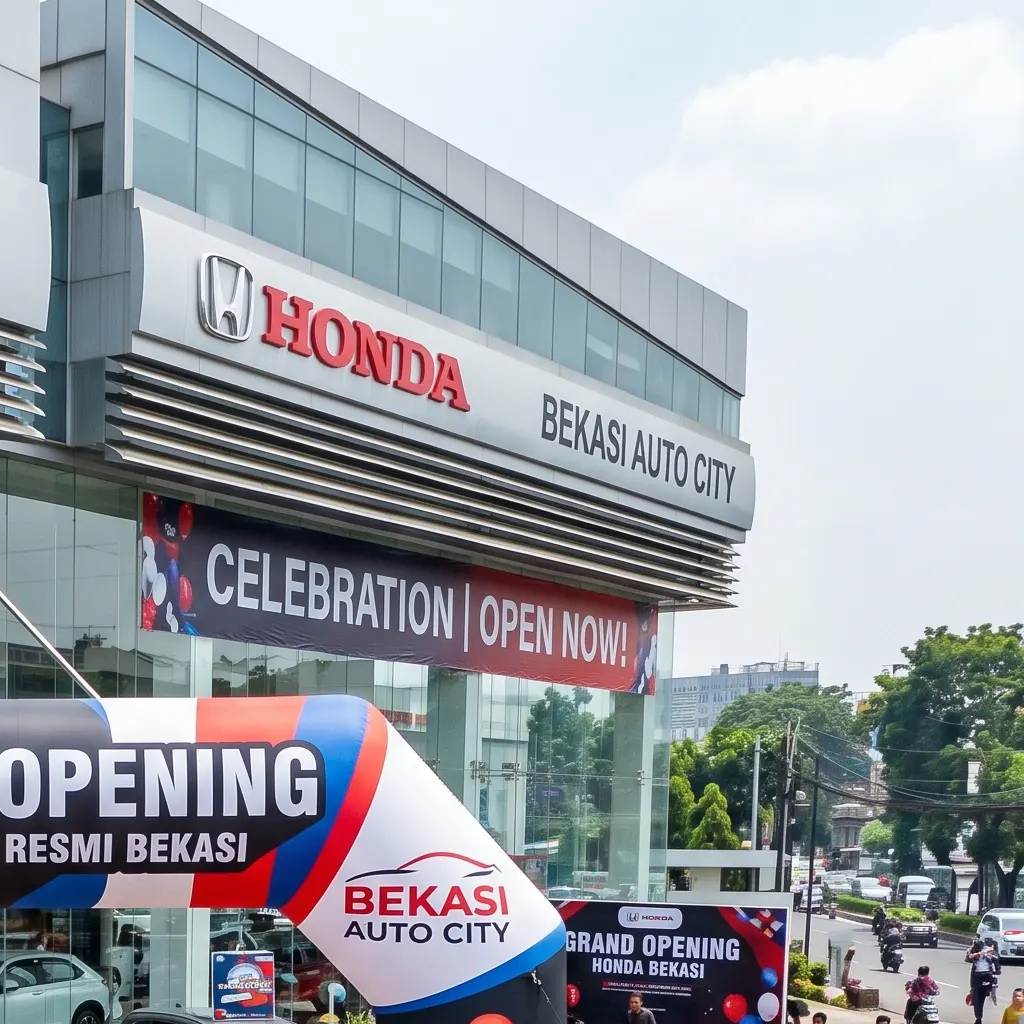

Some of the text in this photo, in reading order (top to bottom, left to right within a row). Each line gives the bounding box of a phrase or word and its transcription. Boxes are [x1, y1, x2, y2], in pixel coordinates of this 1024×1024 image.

[262, 285, 470, 412] HONDA
[541, 393, 737, 504] BEKASI AUTO CITY
[206, 543, 627, 668] CELEBRATION OPEN NOW!
[6, 832, 114, 864] RESMI
[126, 832, 248, 863] BEKASI
[343, 885, 509, 917] BEKASI
[343, 920, 510, 943] AUTO CITY
[566, 930, 741, 961] GRAND OPENING
[592, 958, 705, 979] HONDA BEKASI
